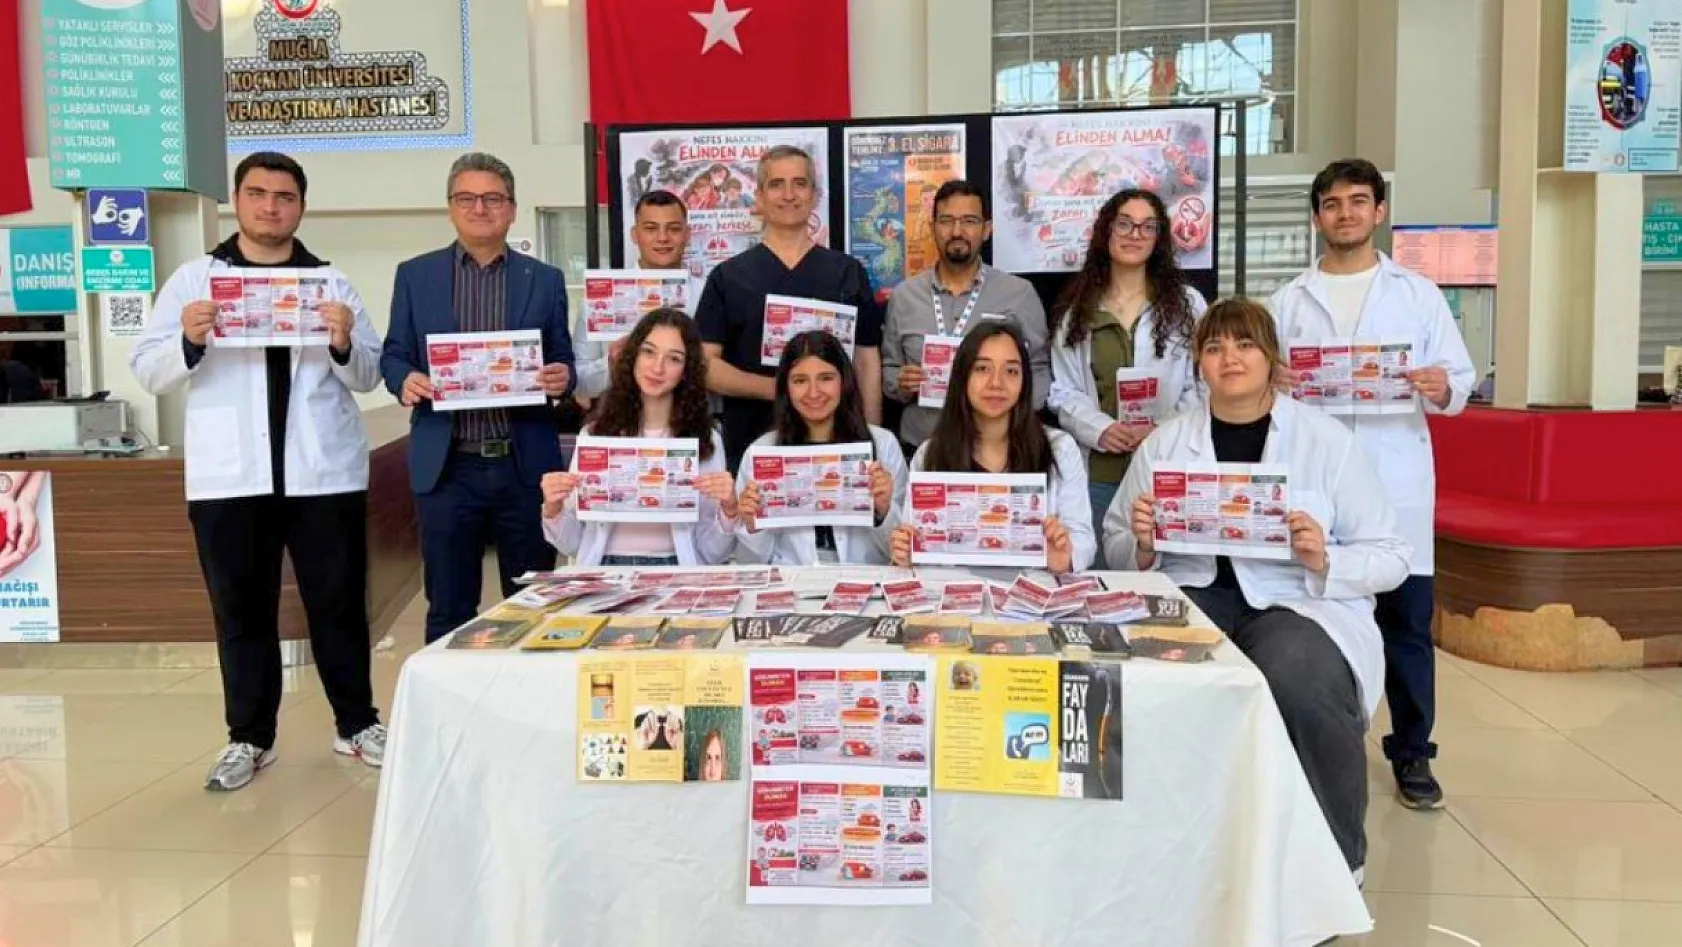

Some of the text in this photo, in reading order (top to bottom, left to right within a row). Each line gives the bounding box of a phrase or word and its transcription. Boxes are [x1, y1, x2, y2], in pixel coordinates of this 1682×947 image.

[58, 19, 98, 32] YATAKLI
[268, 36, 329, 61] MUĞLA
[231, 61, 413, 95] KOÇMAN ÜNİVERSİTESİ
[63, 103, 151, 115] LABORATUVARLAR
[250, 98, 344, 124] ARAŞTIRMA
[347, 91, 435, 117] HASTANESİ
[64, 117, 109, 130] RÖNTGEN
[65, 135, 115, 148] ULTRASON
[1056, 127, 1171, 146] ELİNDEN ALMA!
[679, 144, 736, 161] ELİNDEN
[1063, 681, 1089, 708] FAY
[1063, 708, 1088, 742] DA
[1063, 743, 1089, 764] LARI
